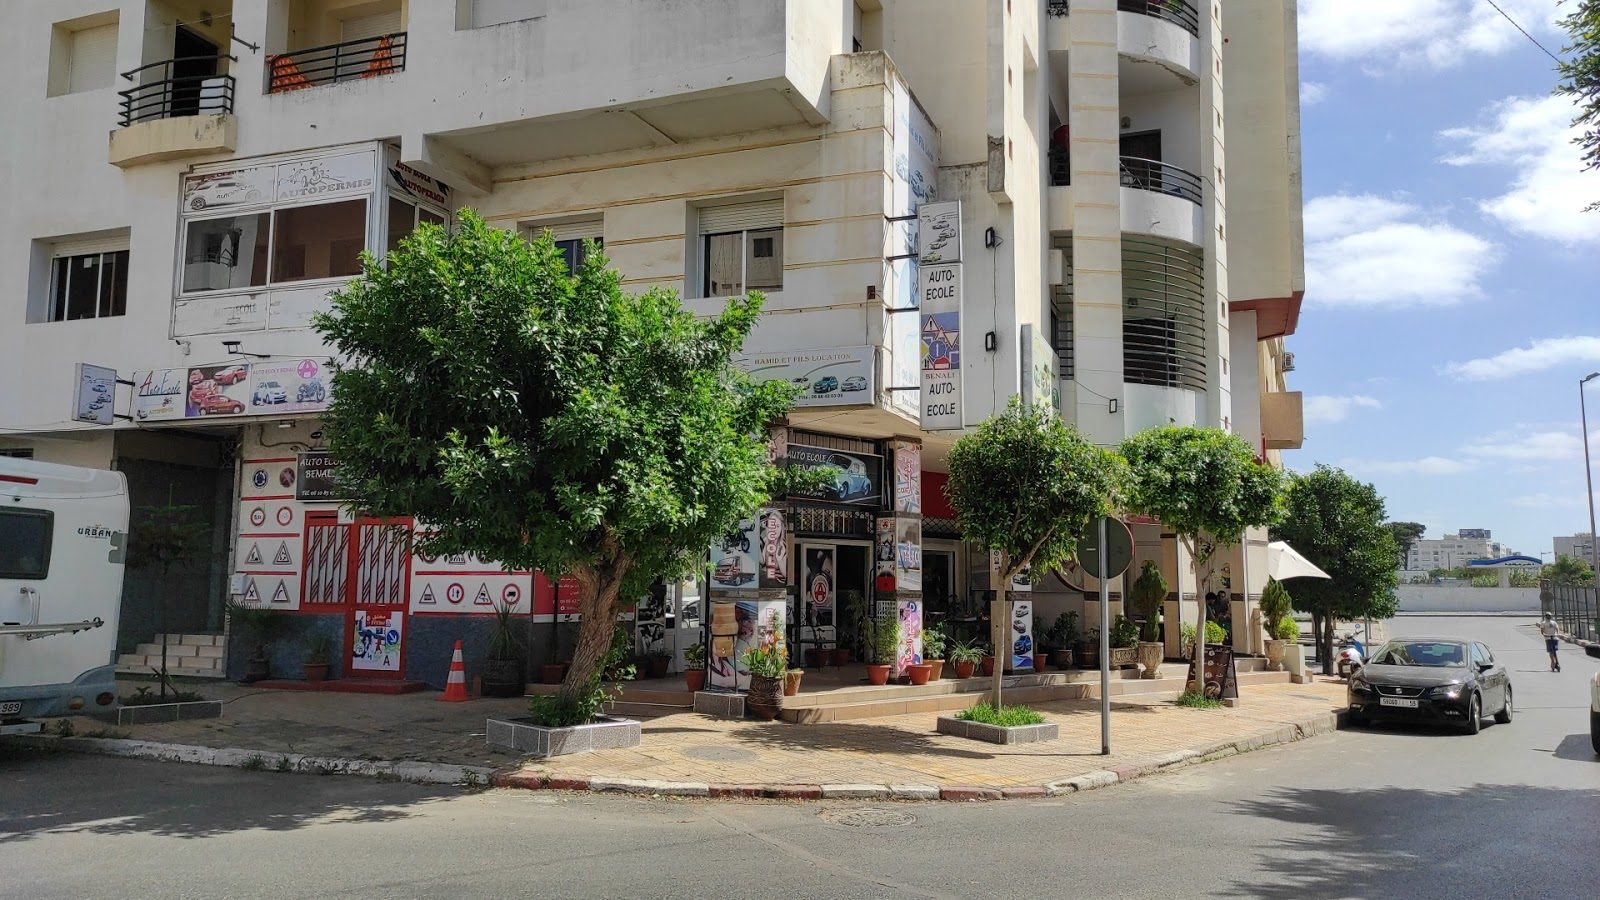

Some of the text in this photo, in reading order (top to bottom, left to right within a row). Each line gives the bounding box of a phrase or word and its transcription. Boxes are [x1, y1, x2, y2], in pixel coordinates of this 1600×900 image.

[280, 178, 372, 200] AUTOPERMIS
[929, 269, 955, 283] AUTO-
[926, 285, 955, 301] ECOLE
[754, 353, 851, 365] HAMID ET FILS LOCATION
[925, 372, 955, 380] BENALI
[929, 382, 956, 396] AUTO-
[927, 402, 956, 417] ECOLE
[300, 457, 347, 466] AUTO ECOL
[787, 449, 827, 463] AUTO ECOLE
[383, 655, 390, 666] A
[1, 703, 20, 712] 989
